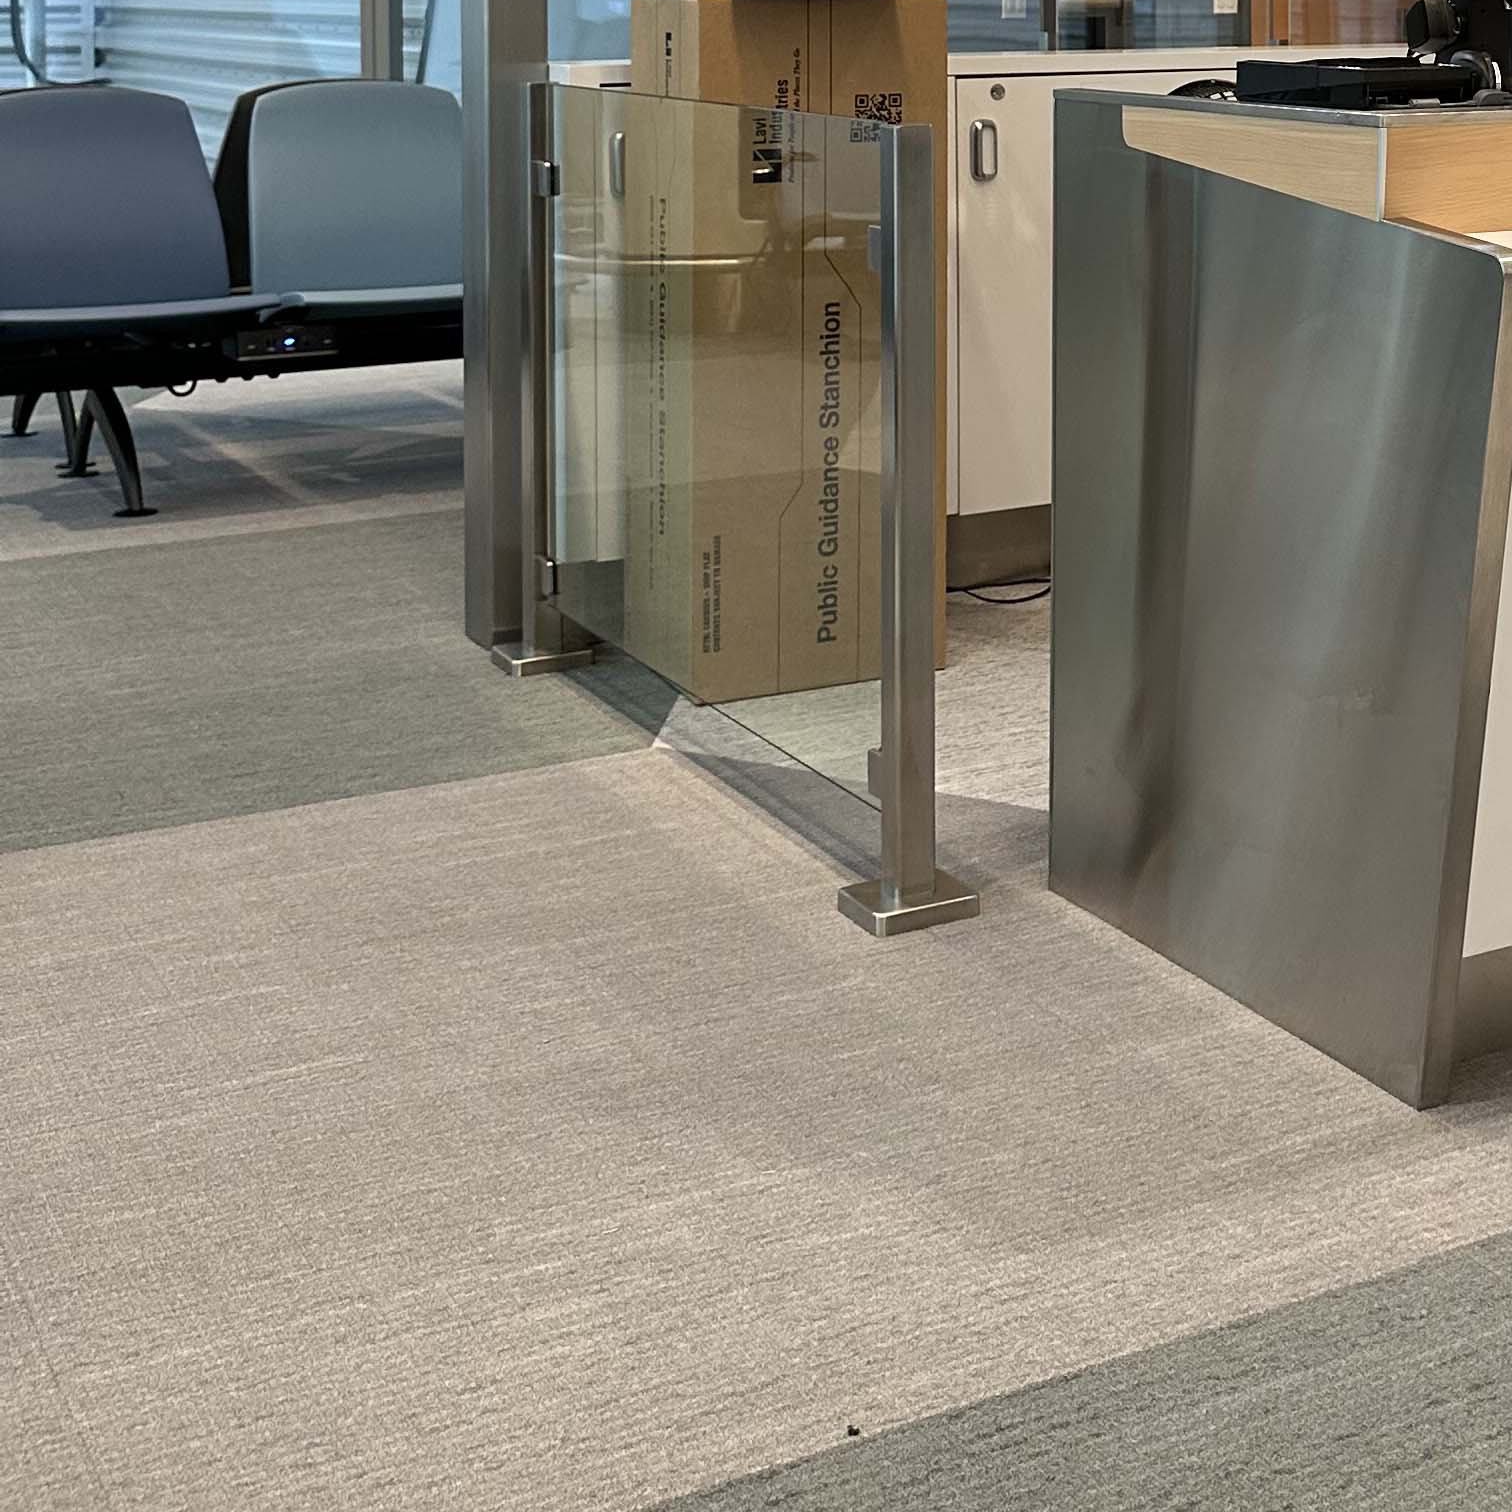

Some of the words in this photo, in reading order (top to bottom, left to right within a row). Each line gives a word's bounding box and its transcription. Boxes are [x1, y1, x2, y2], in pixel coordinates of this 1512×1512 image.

[752, 117, 768, 145] Lavi
[768, 79, 789, 144] Industries
[818, 301, 842, 429] Stanchion
[817, 437, 841, 557] Guidance
[816, 564, 839, 644] Public
